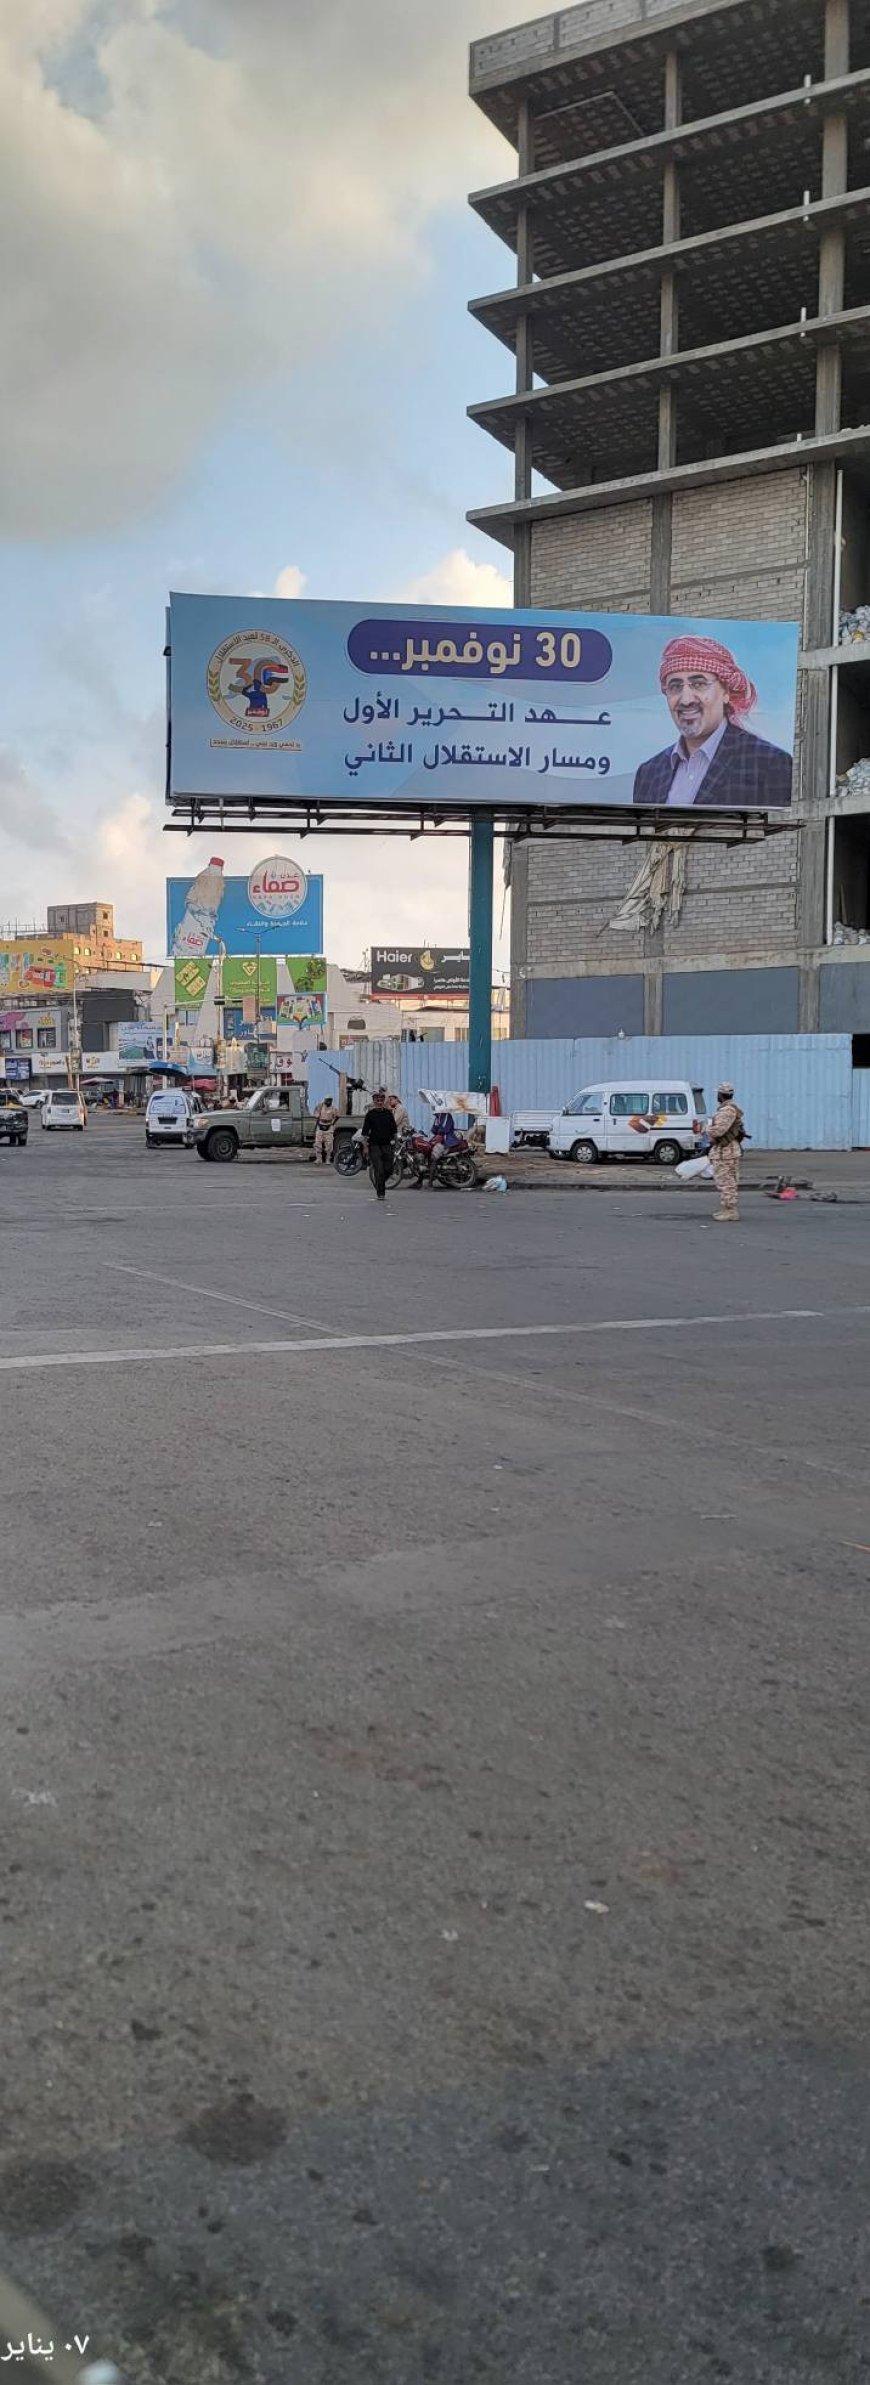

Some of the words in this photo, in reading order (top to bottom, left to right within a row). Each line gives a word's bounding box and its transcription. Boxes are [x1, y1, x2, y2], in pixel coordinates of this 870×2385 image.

[369, 631, 521, 674] نوفمبر...
[535, 632, 581, 668] 30
[343, 691, 400, 724] الأول
[406, 701, 515, 727] التحرير
[229, 716, 253, 732] 2025
[262, 719, 284, 732] 1967
[344, 740, 413, 776] الثاني
[423, 743, 530, 770] الاستقلال
[537, 747, 611, 775] ومسار
[252, 870, 300, 893] صفاء
[377, 950, 412, 963] Haier
